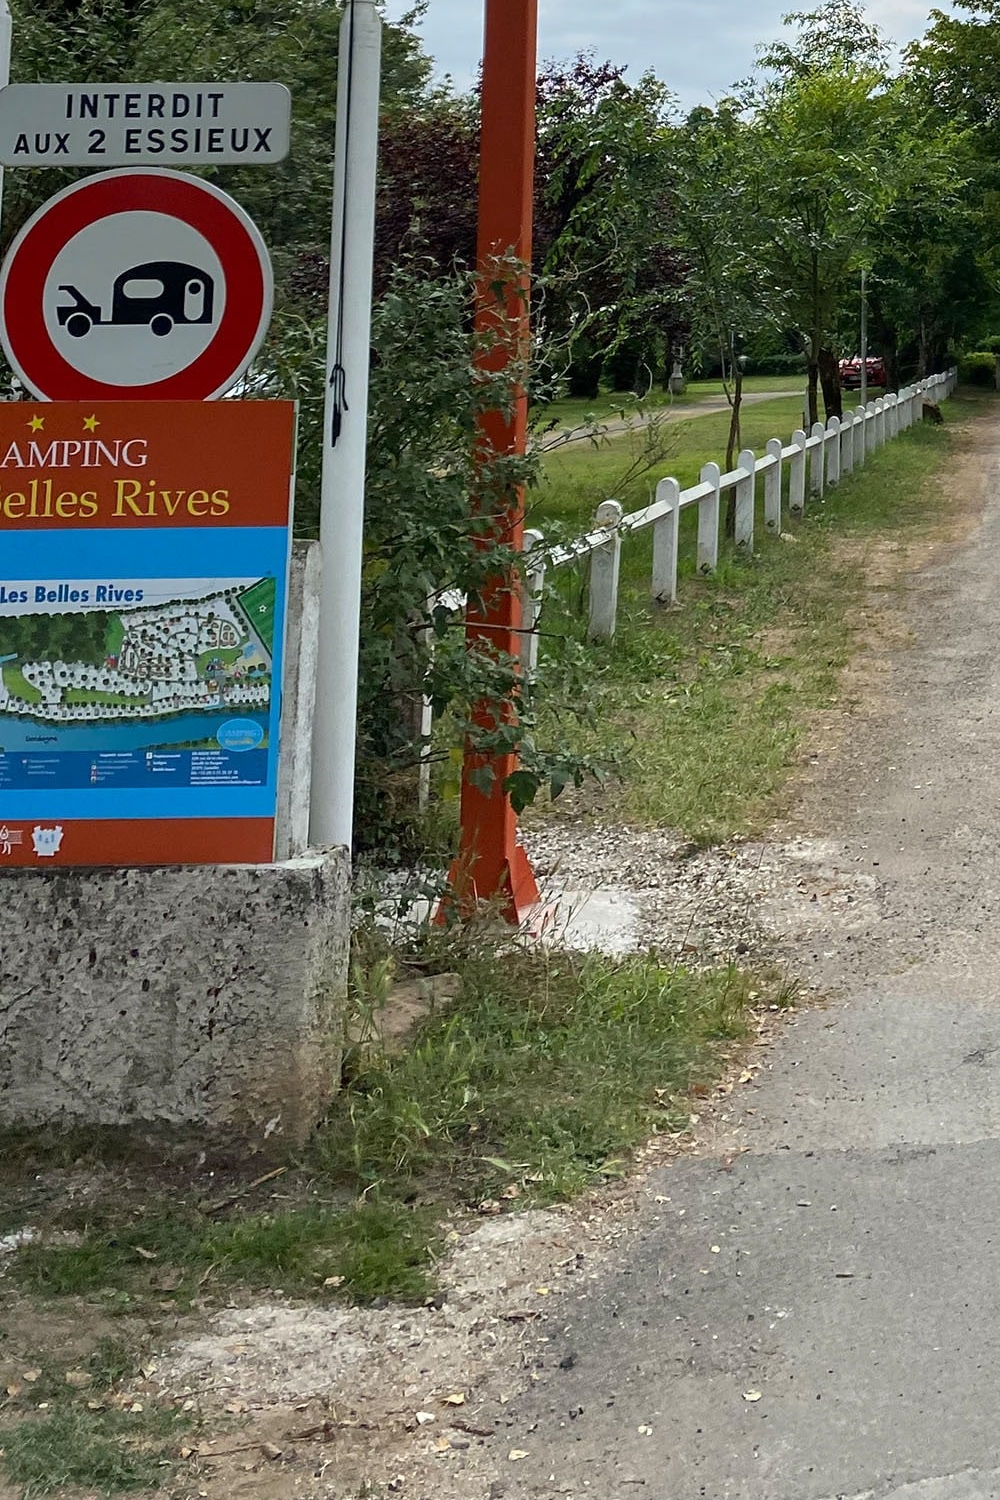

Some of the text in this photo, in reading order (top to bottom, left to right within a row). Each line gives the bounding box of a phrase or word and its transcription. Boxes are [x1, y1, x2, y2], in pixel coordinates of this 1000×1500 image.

[65, 93, 224, 119] INTERDIT
[13, 127, 273, 155] AUX 2 ESSIEUX
[0, 439, 148, 469] AMPING
[0, 479, 230, 519] elles Rives
[0, 584, 144, 604] Les Belles Rives
